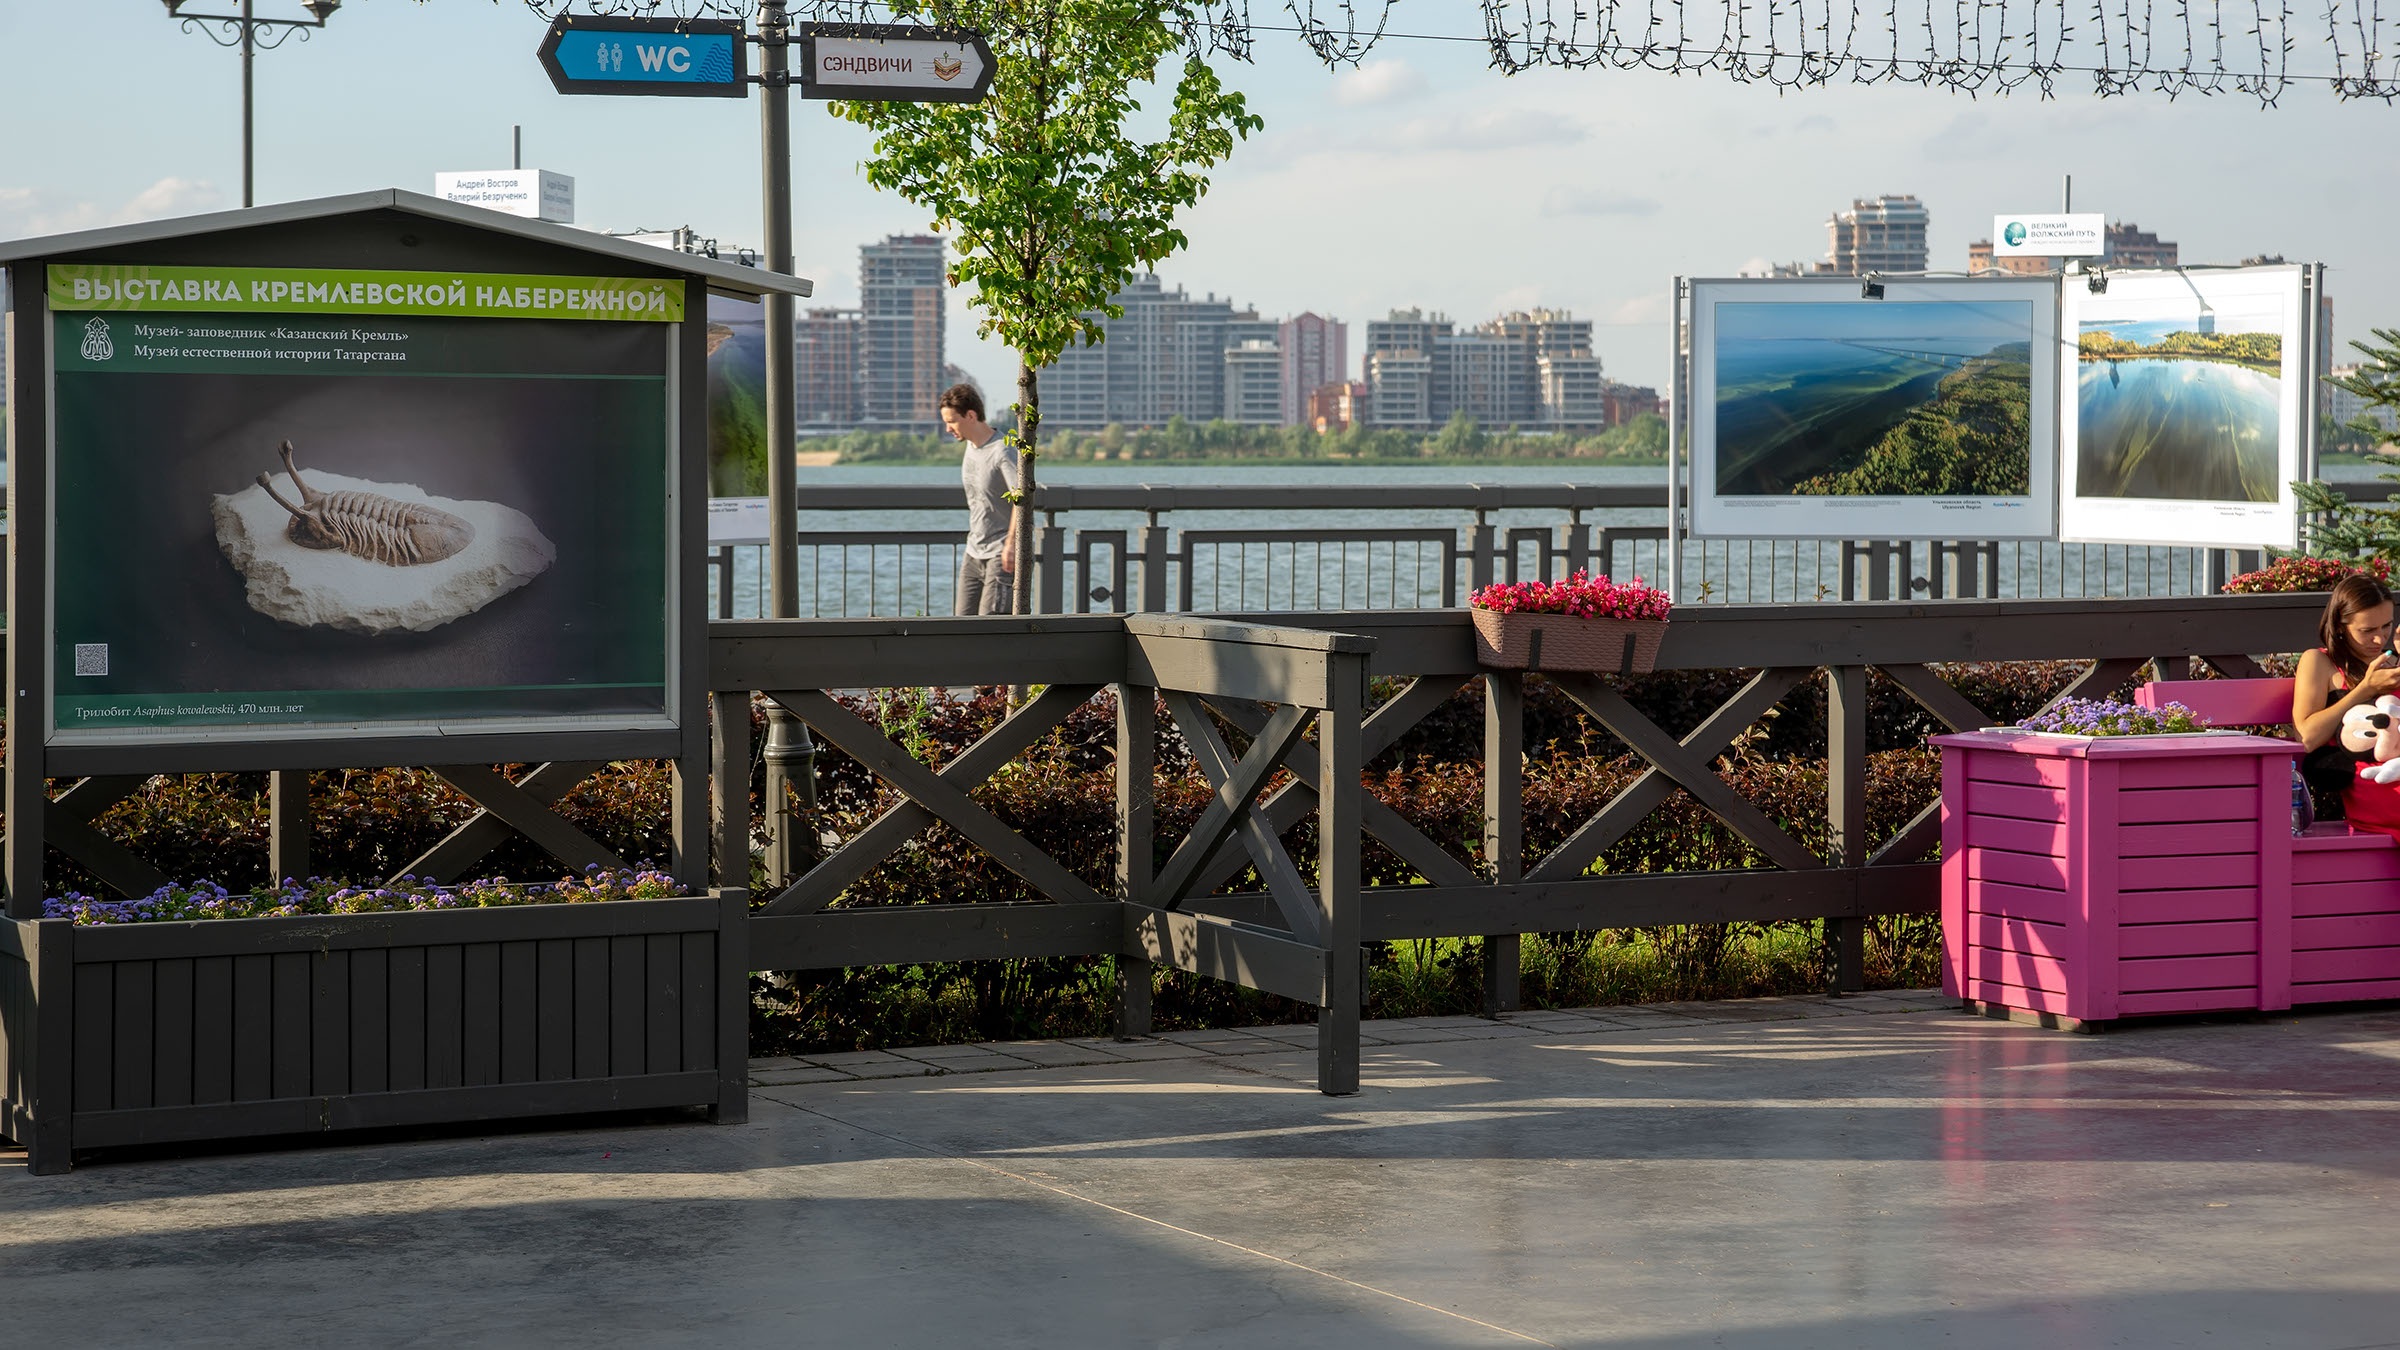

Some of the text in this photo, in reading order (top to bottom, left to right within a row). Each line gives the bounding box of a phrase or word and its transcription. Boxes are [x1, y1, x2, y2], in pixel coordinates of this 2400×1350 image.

[636, 45, 691, 73] WC
[823, 56, 913, 74] СЭНДВИЧИ
[456, 179, 519, 189] Андрей Востров
[2031, 221, 2067, 229] ВЕЛИКИЙ
[73, 278, 666, 312] ВЫСТАВКА КРЕМЛЕВСКОЙ НАБЕРЕЖНОЙ
[134, 323, 409, 342] Музей- заповедник «Казанский Кремль»
[134, 344, 407, 362] Музей естественной истории Татарстана
[75, 704, 304, 721] Трилобит Asaphus kowalewskii, 470 млн. лет
